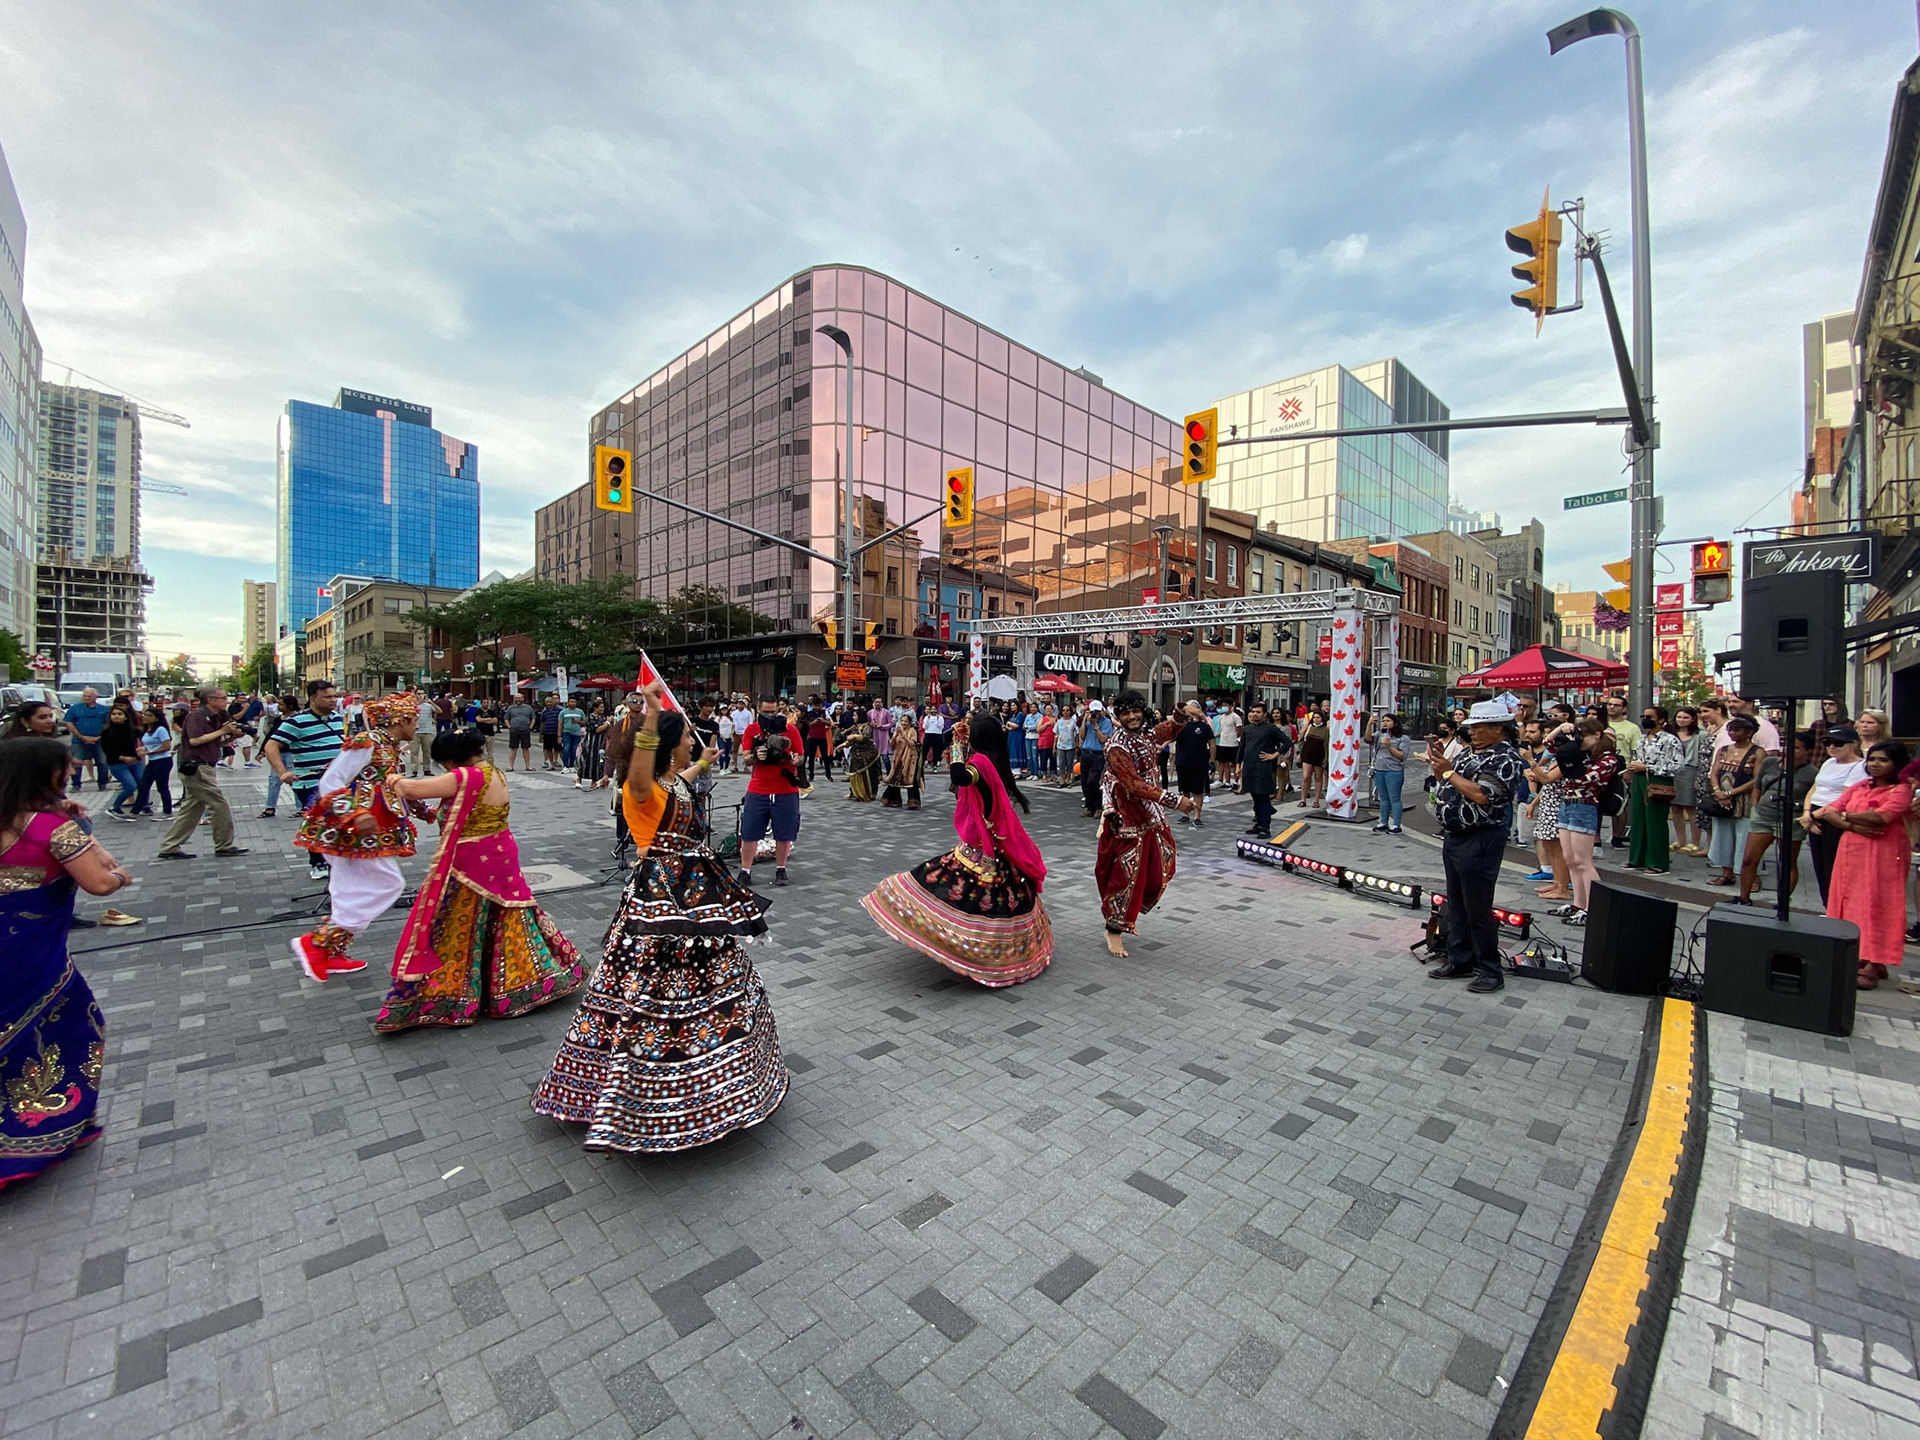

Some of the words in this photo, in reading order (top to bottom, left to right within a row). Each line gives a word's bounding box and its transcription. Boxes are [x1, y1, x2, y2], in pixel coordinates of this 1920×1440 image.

[404, 403, 430, 414] LAKE
[1270, 419, 1311, 434] FANSHAWE
[1566, 493, 1608, 508] Talbot
[1614, 490, 1624, 499] St
[1755, 549, 1787, 565] The
[1777, 550, 1868, 574] Inkery
[1659, 623, 1678, 631] LHC
[1043, 653, 1124, 675] CINNAHOLIC
[1549, 672, 1565, 680] GREAT
[1565, 671, 1577, 679] BEER
